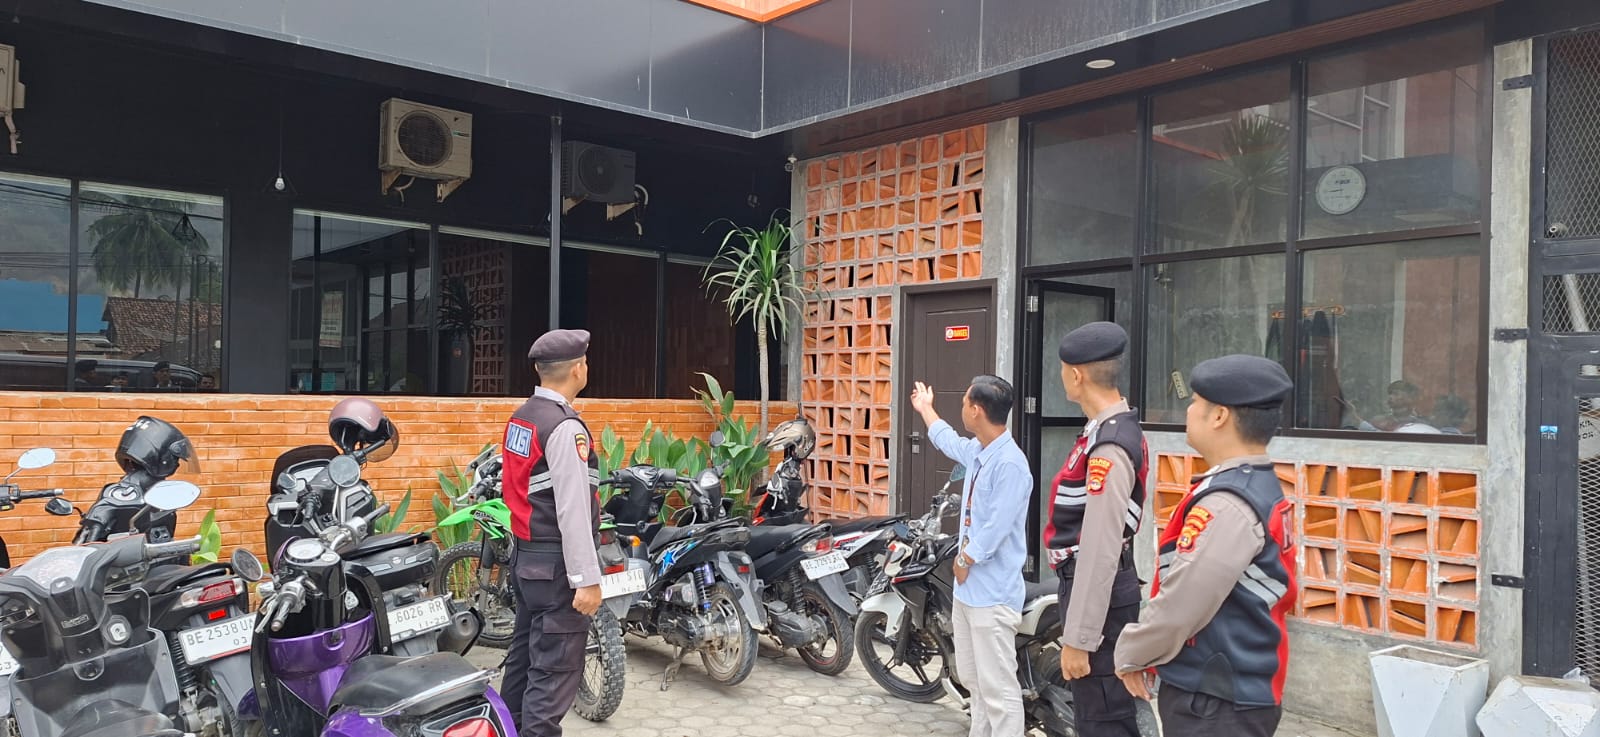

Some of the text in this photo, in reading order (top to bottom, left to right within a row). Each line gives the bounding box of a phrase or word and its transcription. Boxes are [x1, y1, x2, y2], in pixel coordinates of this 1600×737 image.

[396, 600, 443, 623] 6026 RR
[186, 631, 204, 646] BE
[206, 623, 239, 641] 2538
